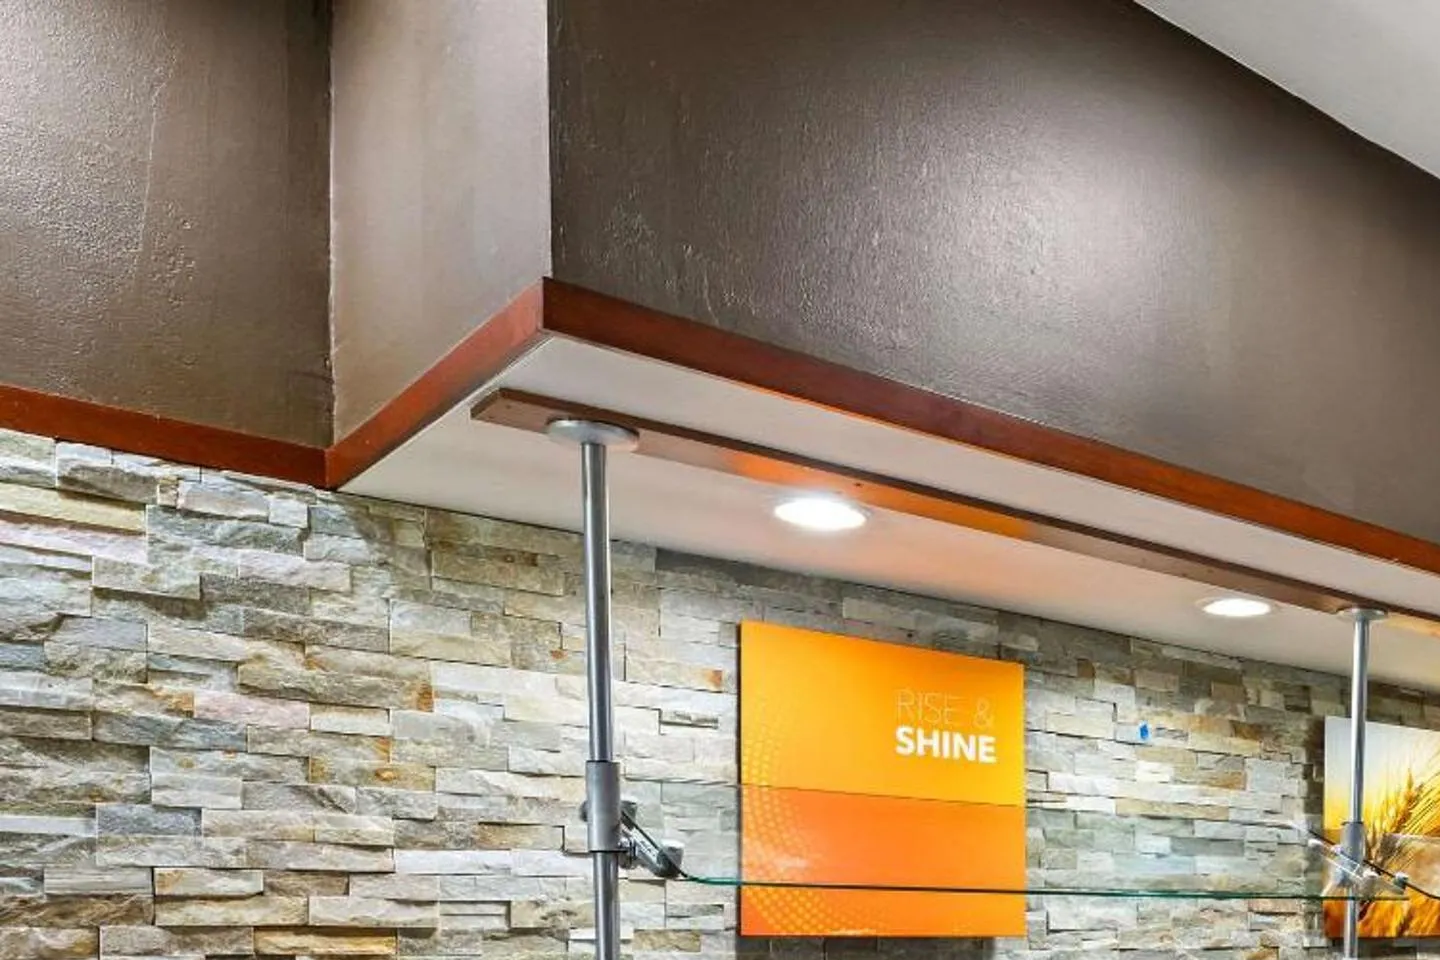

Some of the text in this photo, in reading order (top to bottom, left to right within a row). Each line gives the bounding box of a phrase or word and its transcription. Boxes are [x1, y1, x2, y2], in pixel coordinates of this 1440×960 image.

[895, 688, 995, 730] RISE &
[895, 725, 997, 764] SHINE
